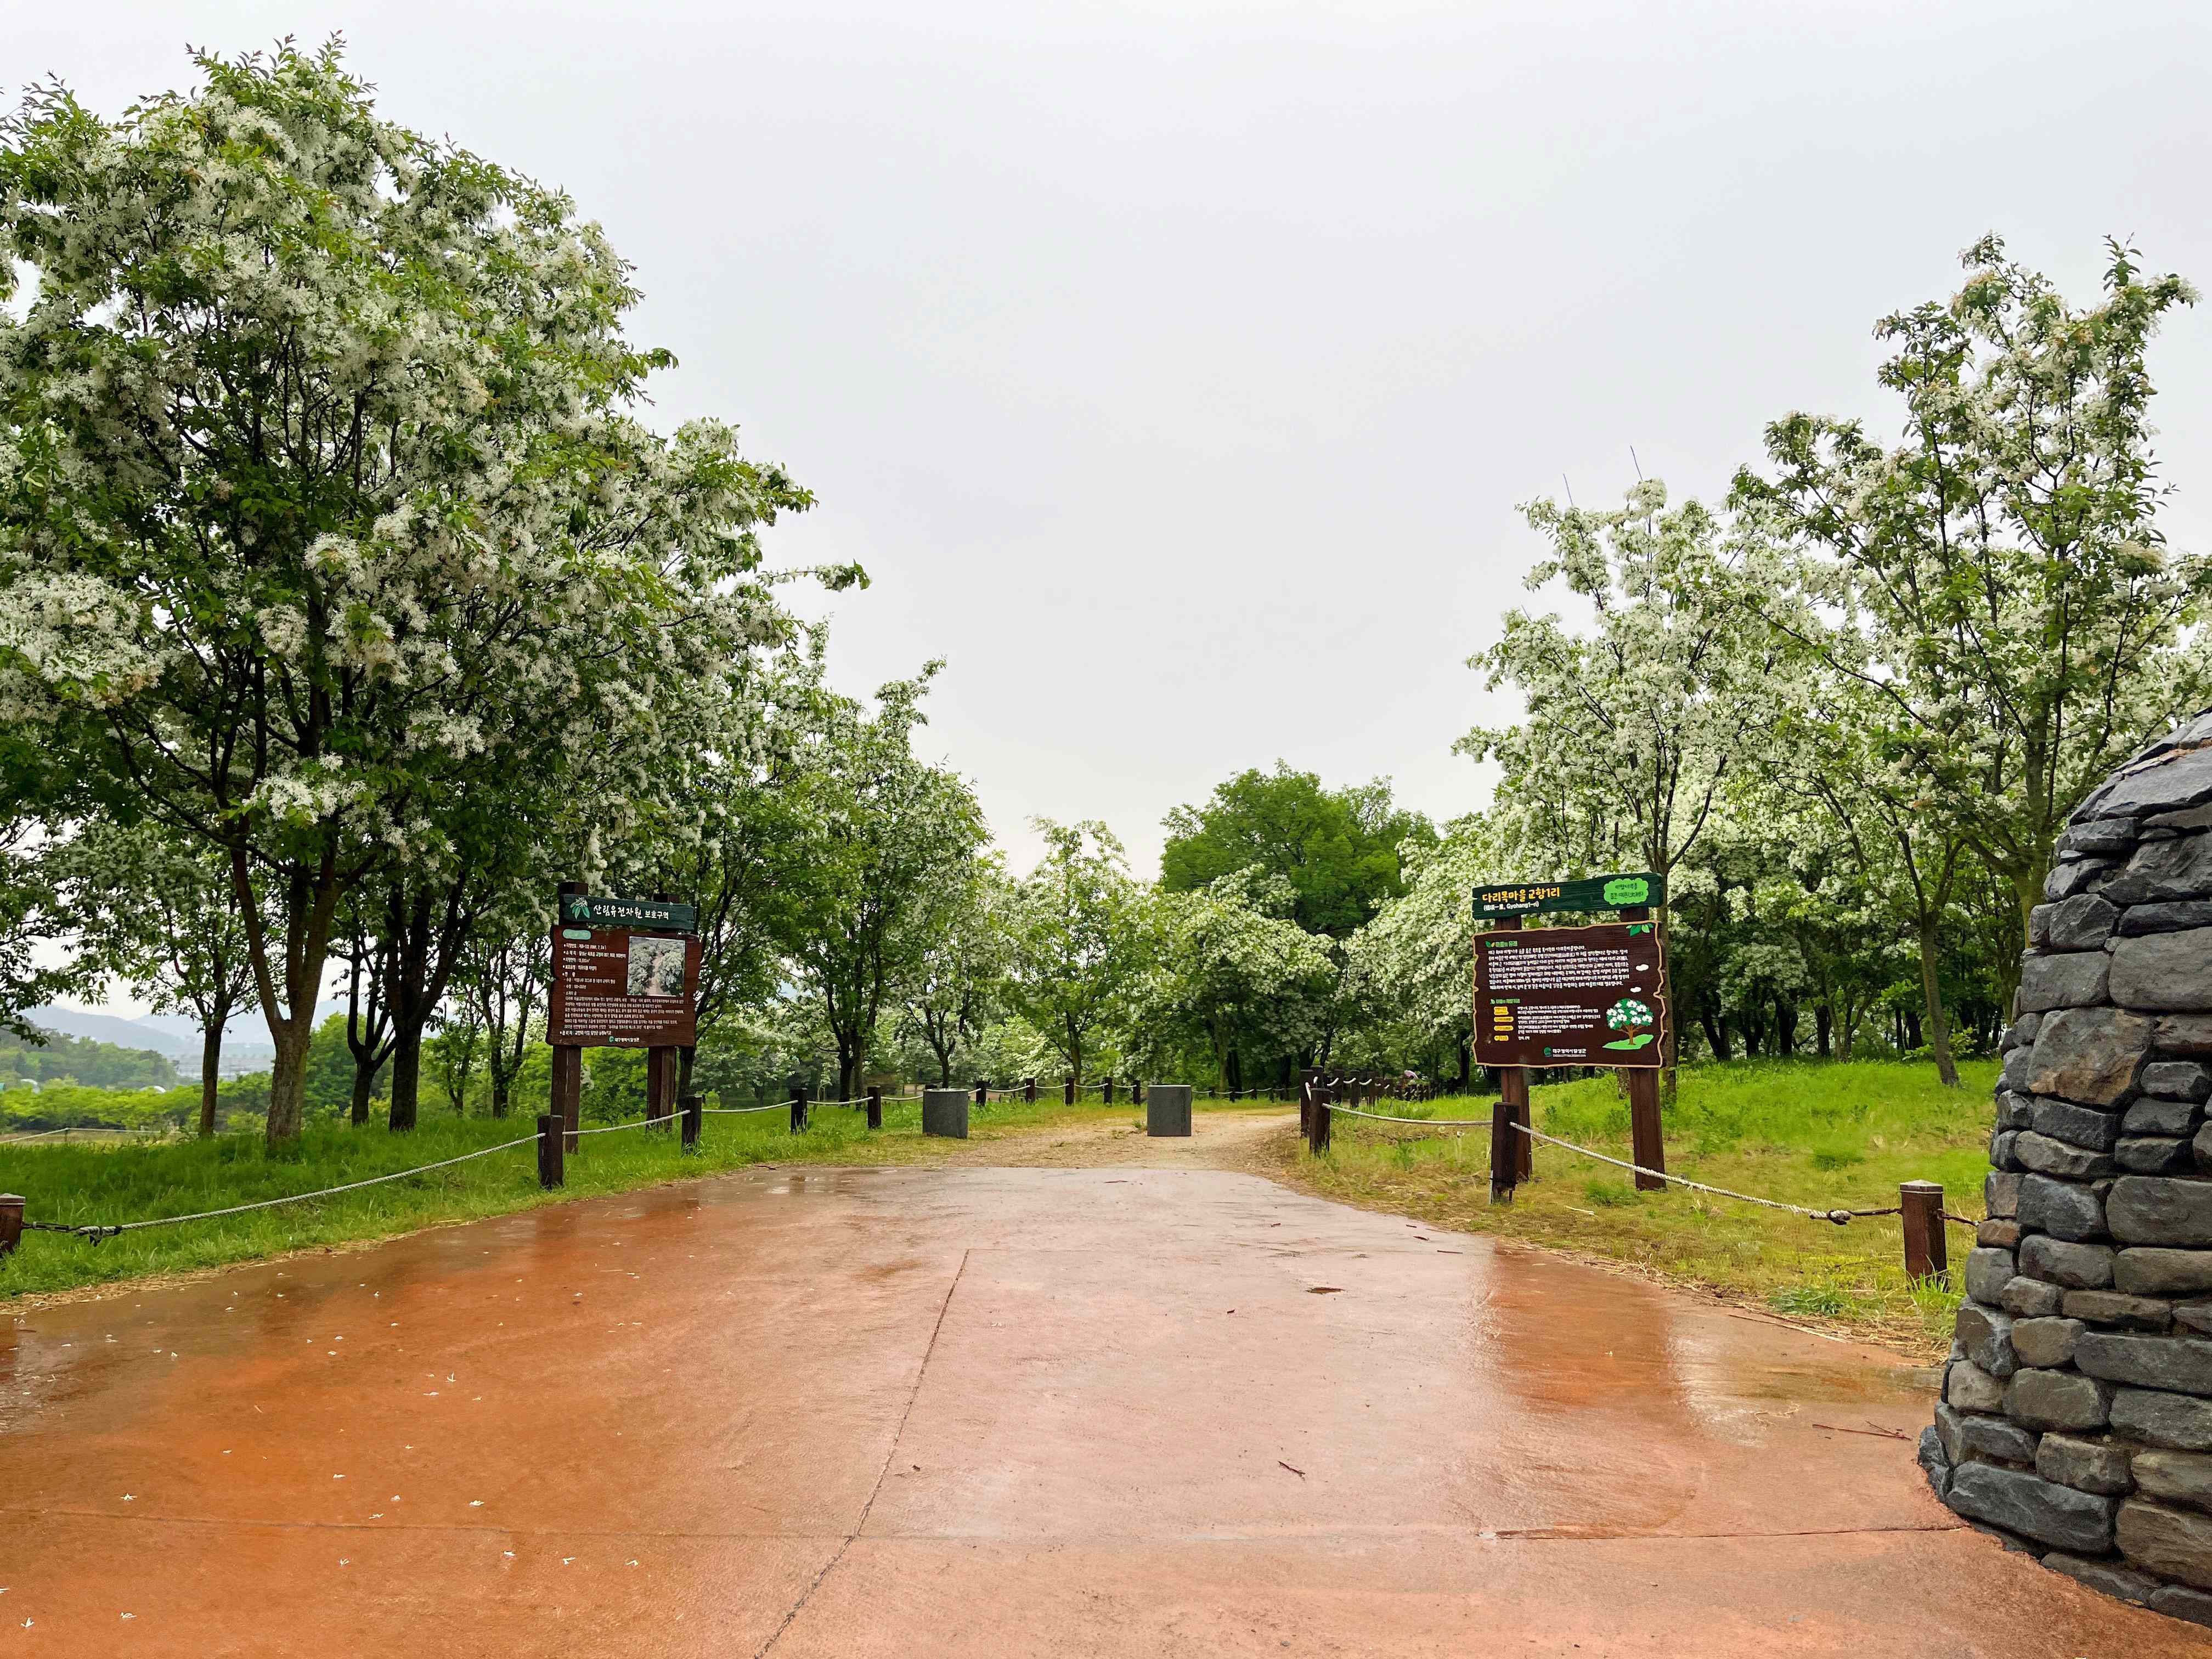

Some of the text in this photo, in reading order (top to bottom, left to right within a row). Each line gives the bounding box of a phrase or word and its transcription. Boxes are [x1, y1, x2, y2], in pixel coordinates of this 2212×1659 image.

[1482, 887, 1560, 902] 다리목마을 교항1리
[593, 905, 669, 920] 산림유전자원 보호구역
